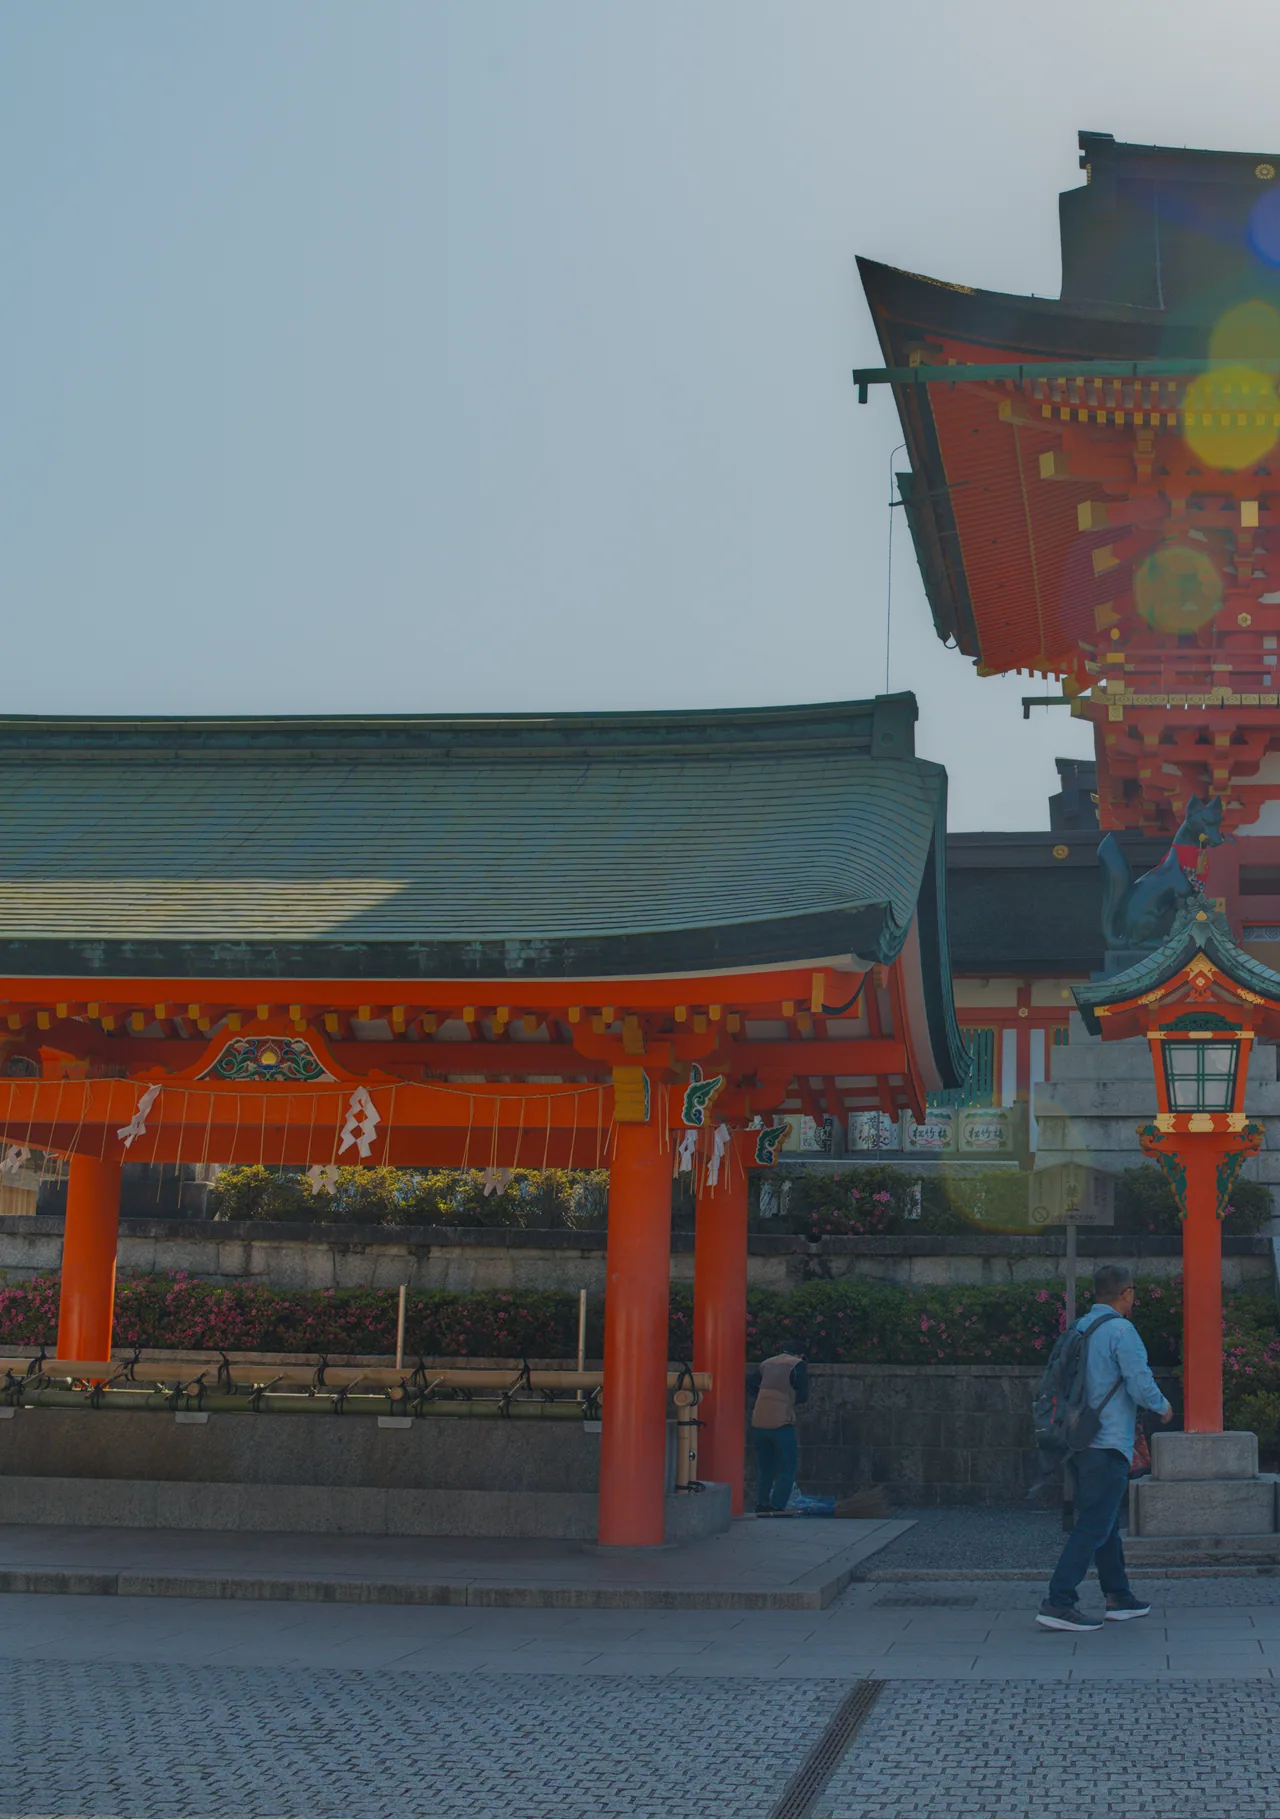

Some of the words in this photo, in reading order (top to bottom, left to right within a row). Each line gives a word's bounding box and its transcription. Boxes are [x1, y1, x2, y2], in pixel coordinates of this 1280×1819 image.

[913, 1126, 949, 1139] 松竹梅
[968, 1126, 1005, 1139] 松竹梅
